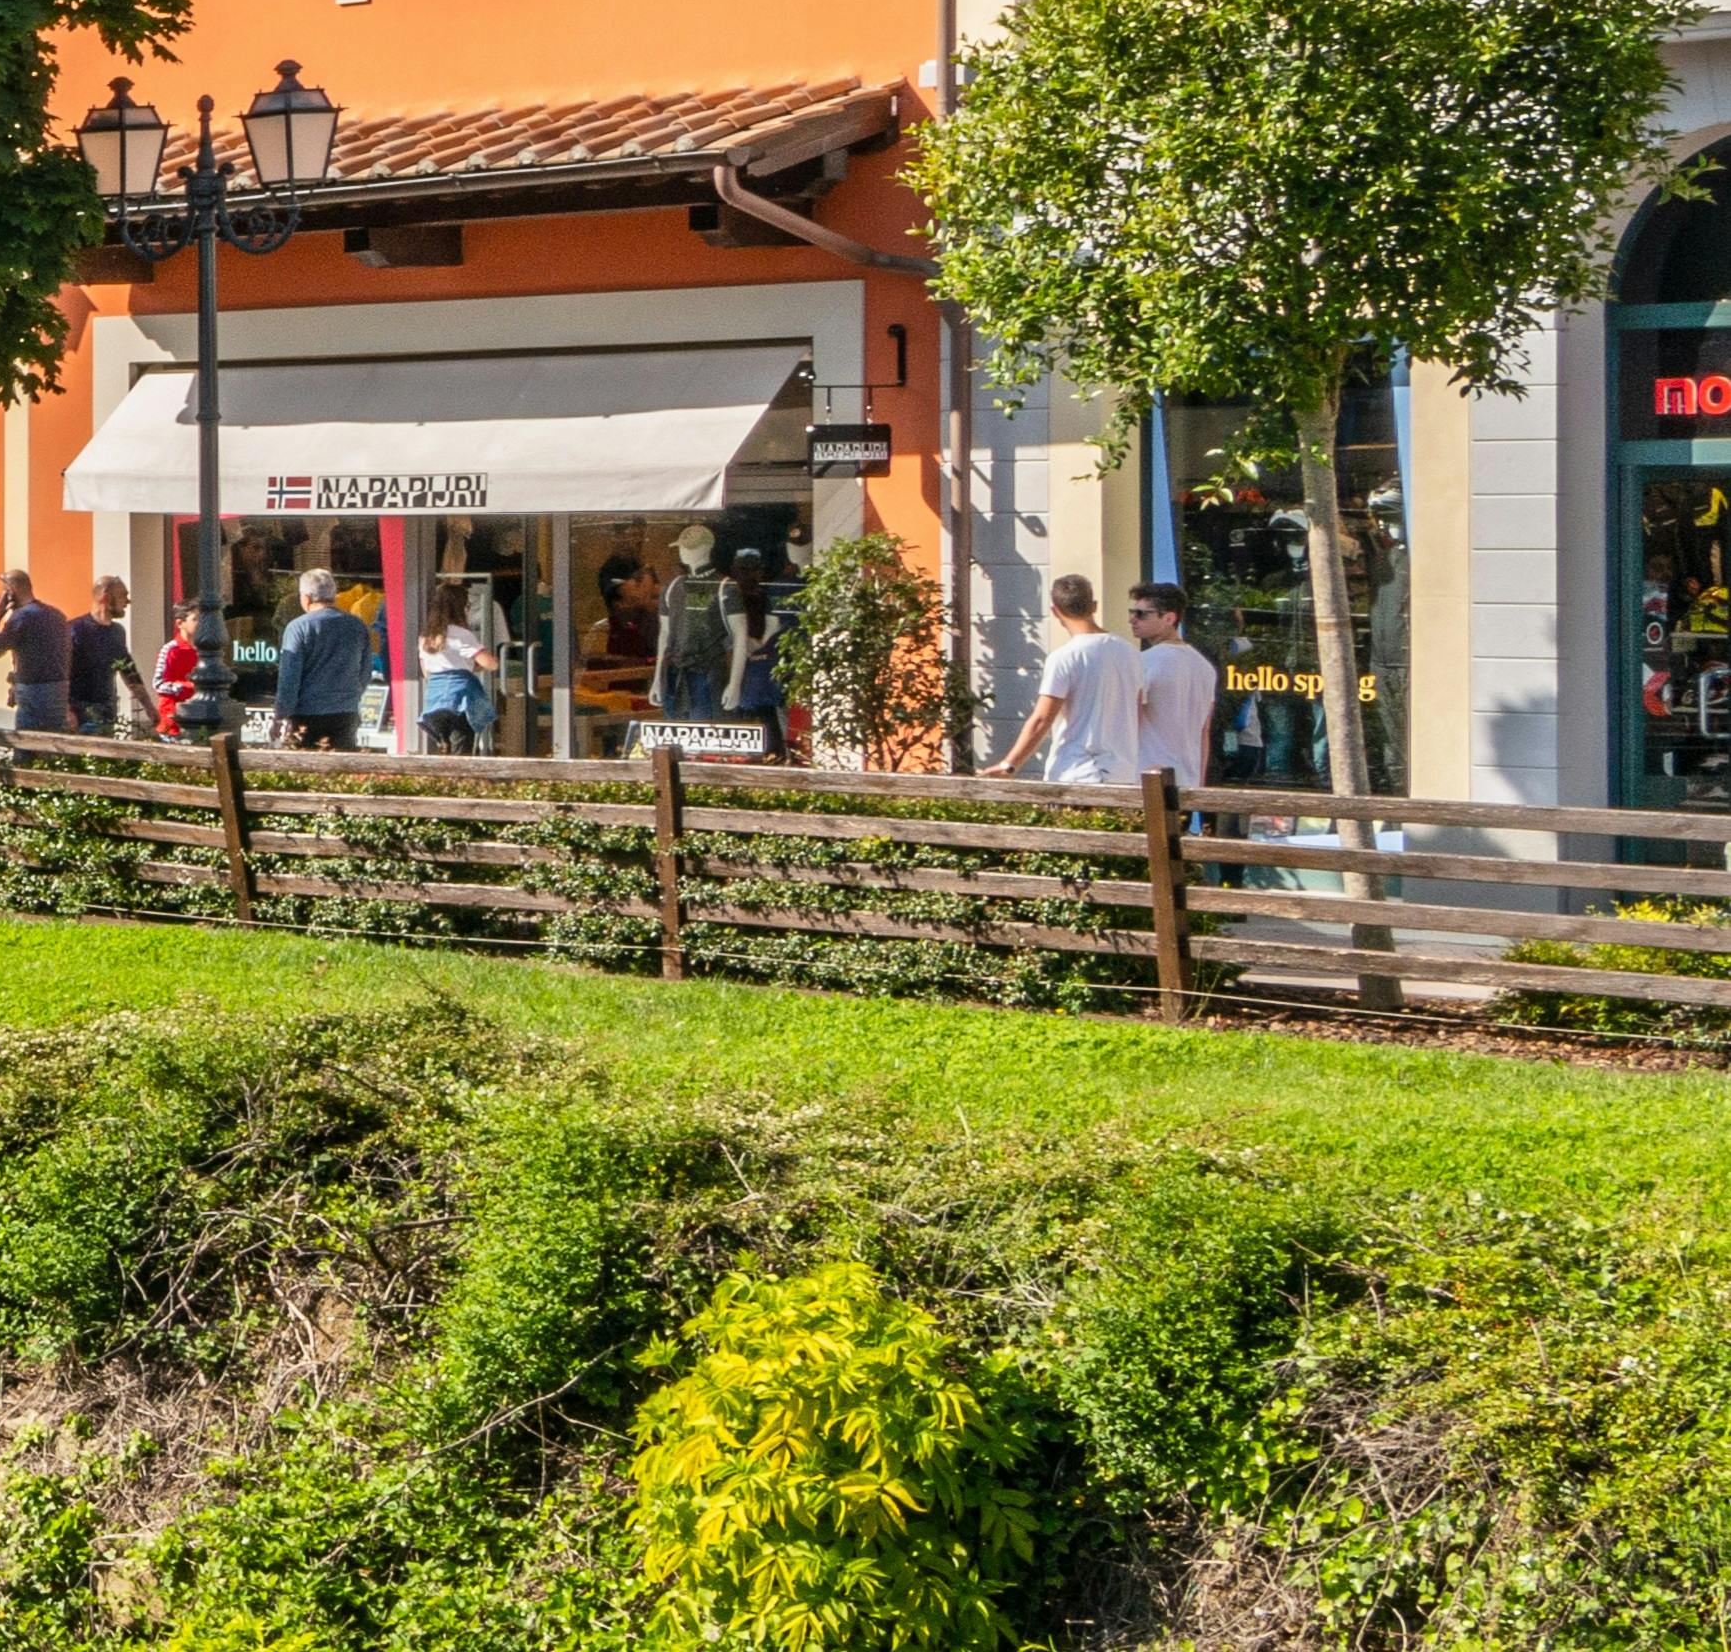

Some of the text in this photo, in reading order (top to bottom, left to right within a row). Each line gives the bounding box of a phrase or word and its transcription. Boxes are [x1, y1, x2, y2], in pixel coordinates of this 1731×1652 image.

[320, 475, 486, 508] NAPAPIJRI
[233, 640, 277, 661] hello
[1226, 665, 1377, 702] hello spg
[645, 725, 760, 750] NAPAPIJRI
